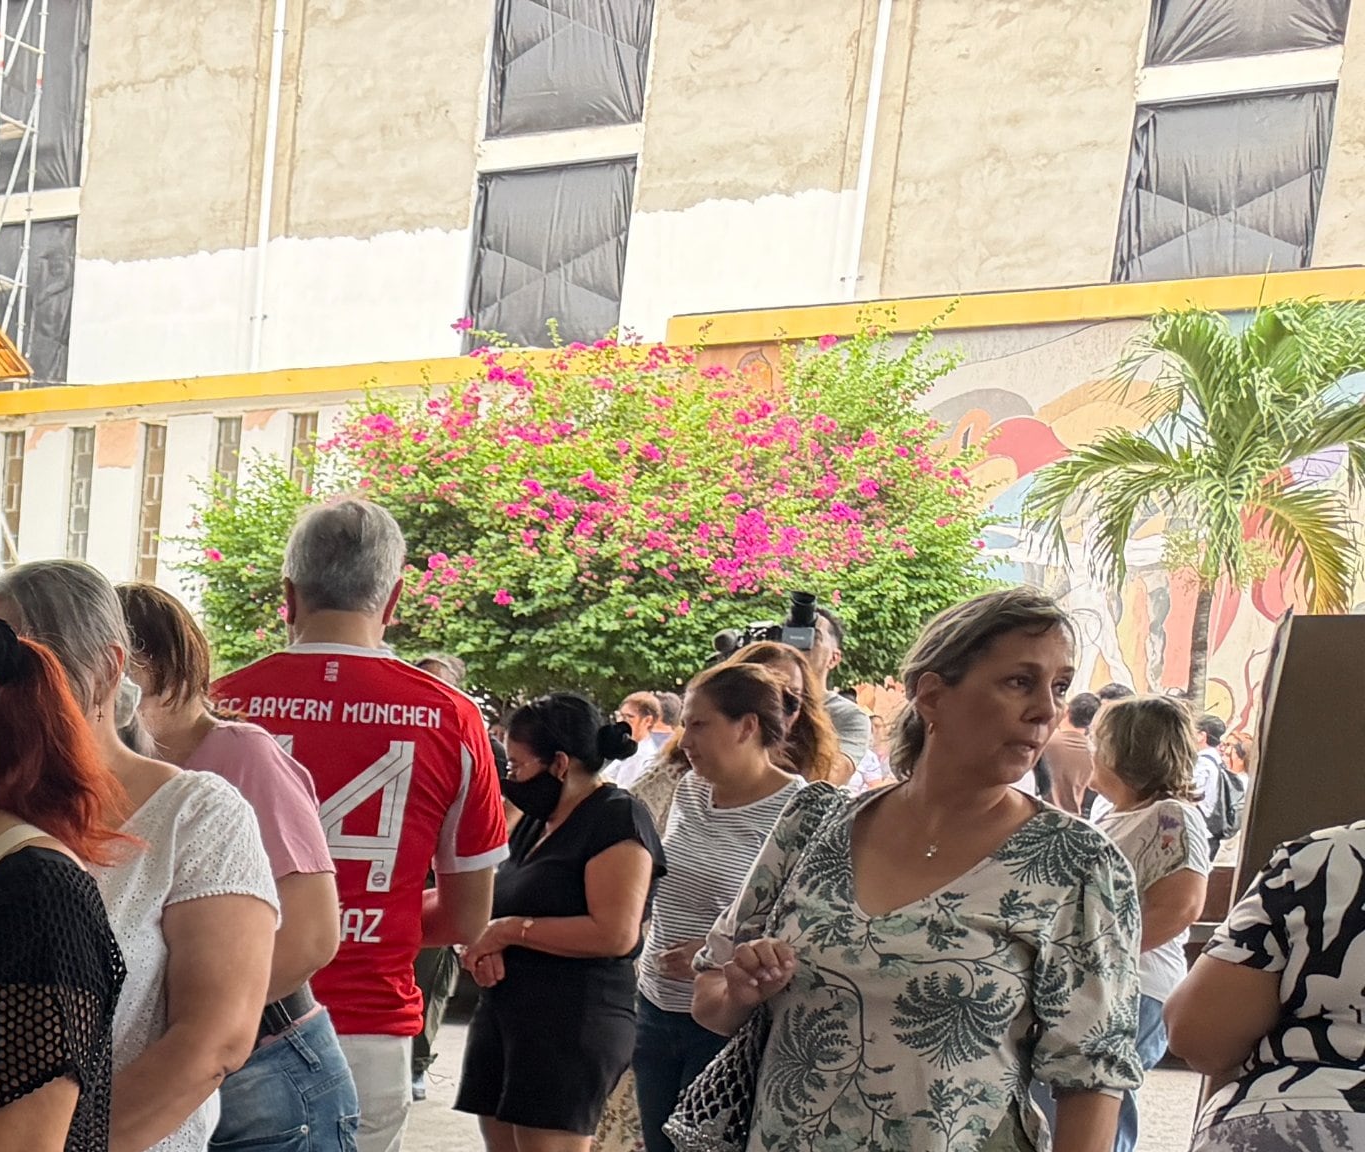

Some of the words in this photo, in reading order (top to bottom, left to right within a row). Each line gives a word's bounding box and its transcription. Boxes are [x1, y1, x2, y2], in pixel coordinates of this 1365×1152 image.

[249, 697, 332, 721] BAYERN
[342, 702, 442, 728] MÜNCHEN
[272, 735, 415, 892] 4
[340, 902, 383, 943] AZ
